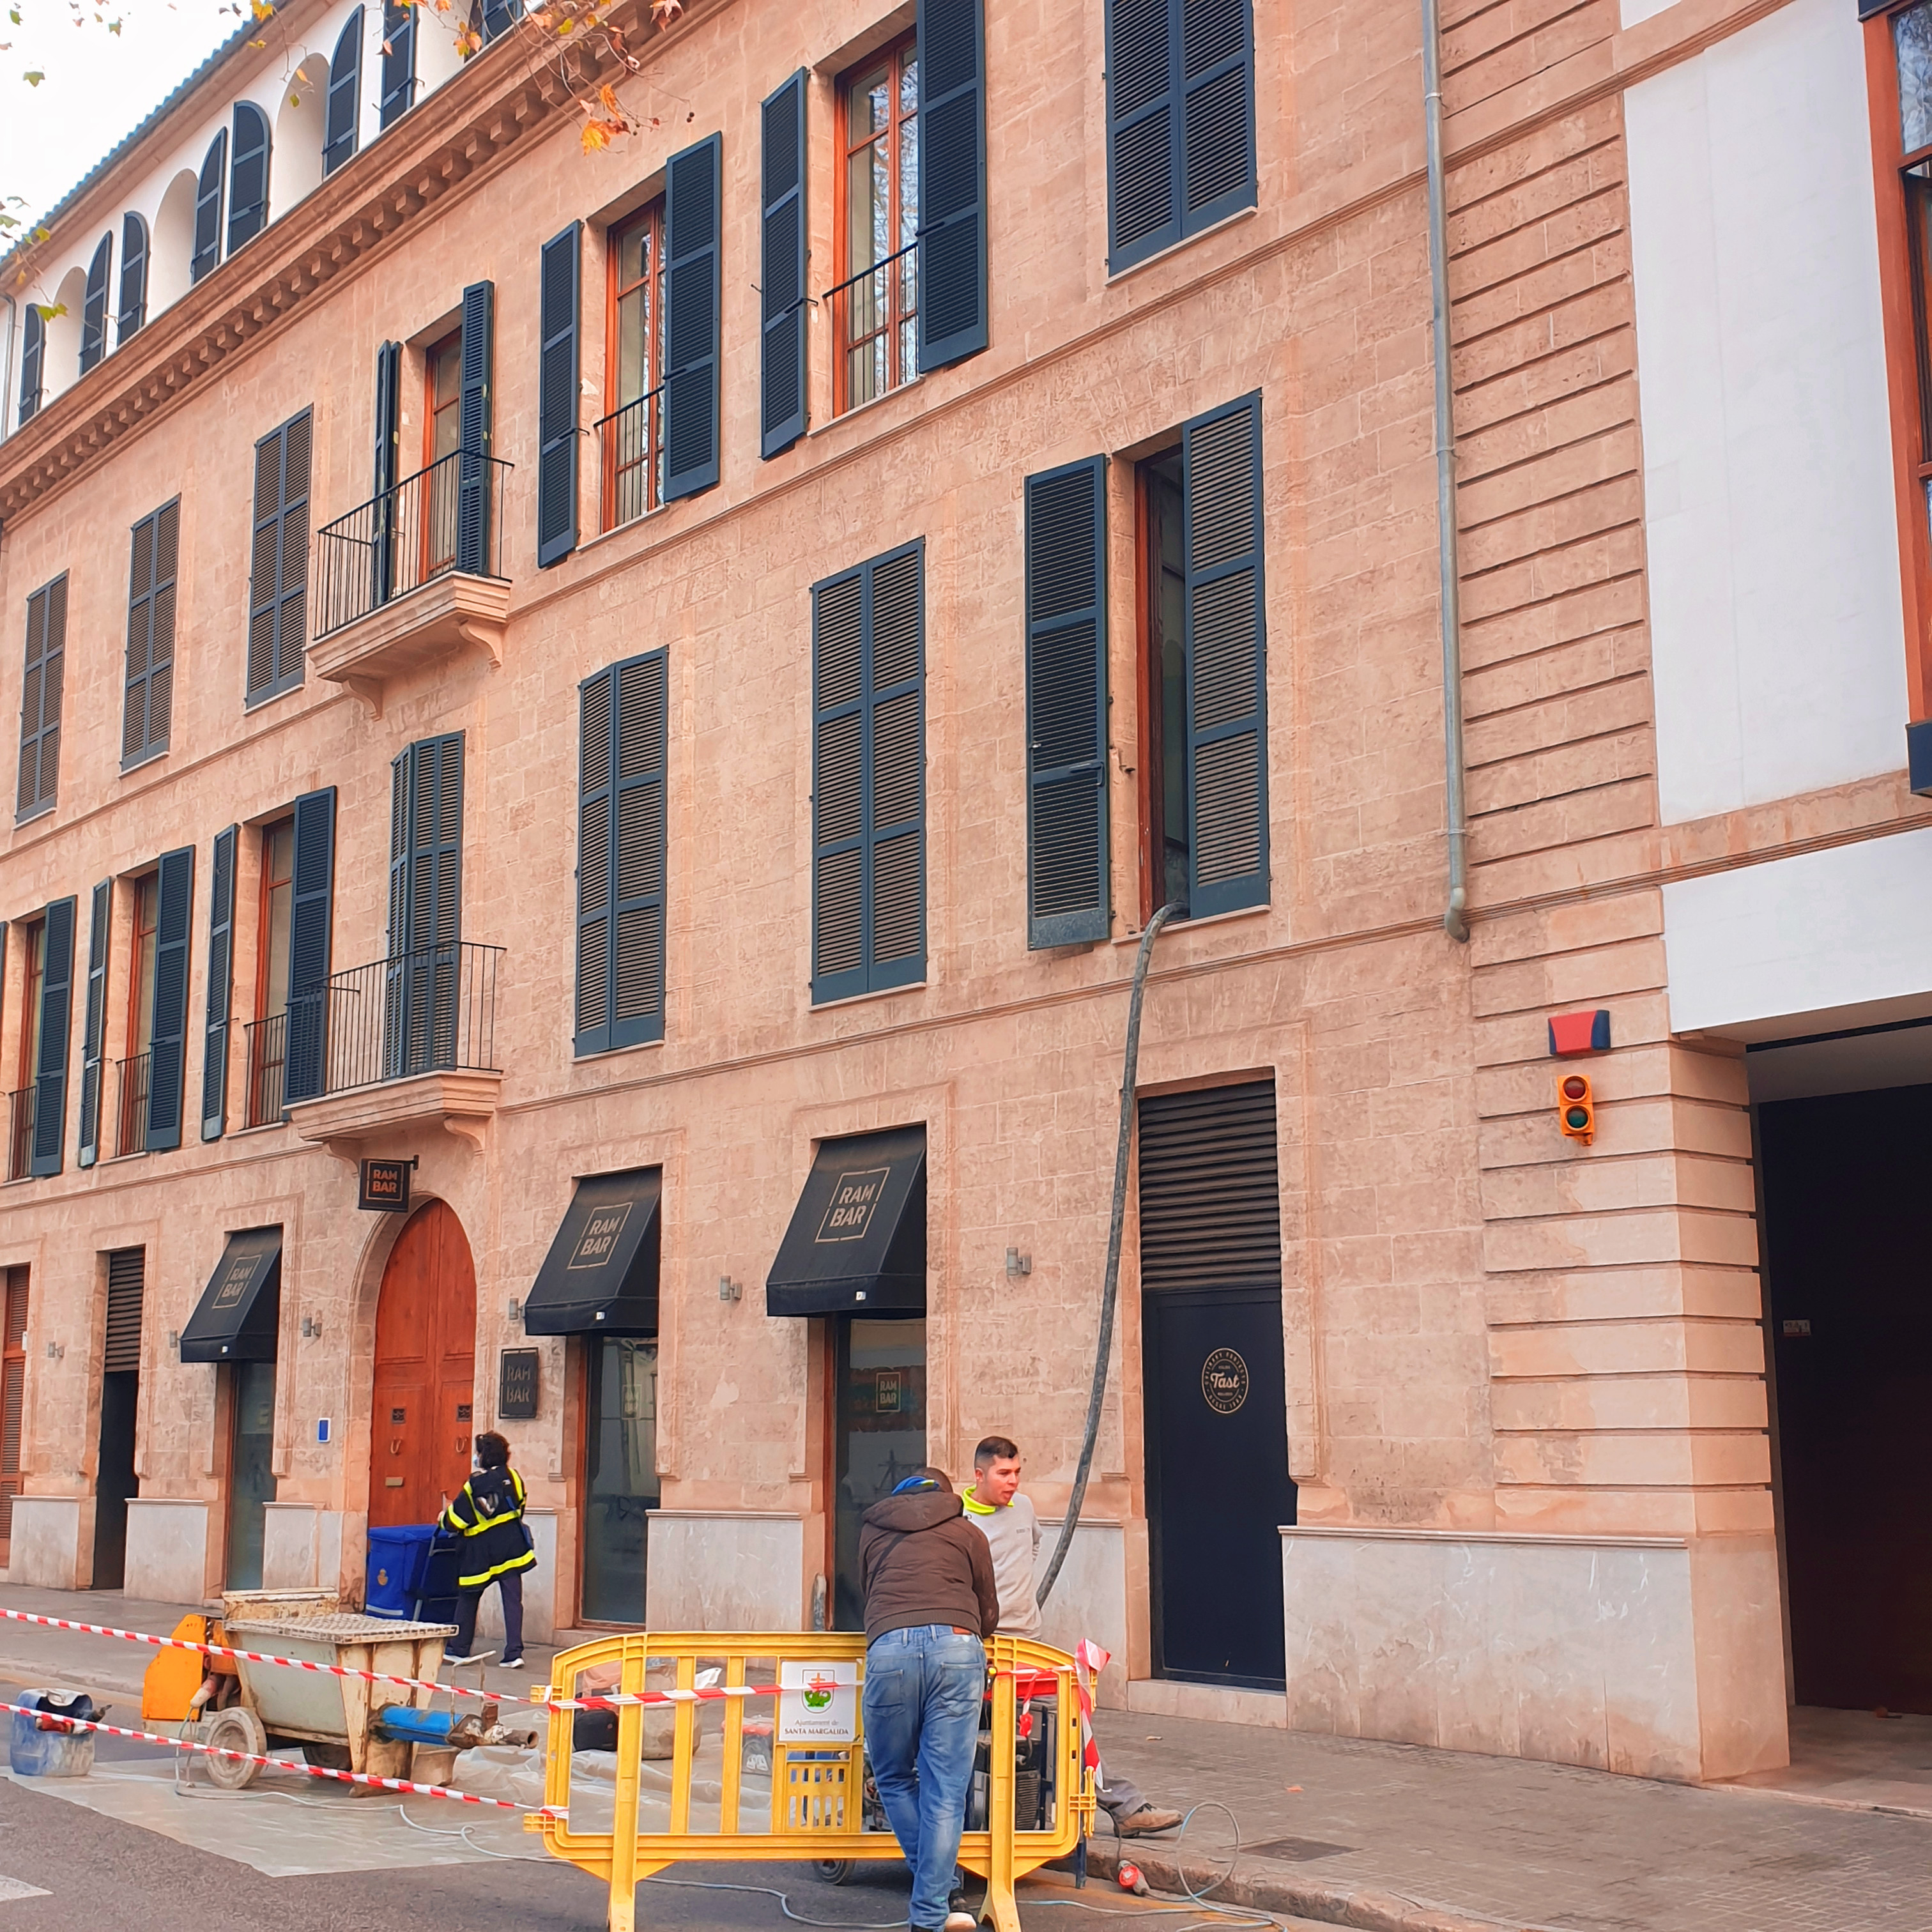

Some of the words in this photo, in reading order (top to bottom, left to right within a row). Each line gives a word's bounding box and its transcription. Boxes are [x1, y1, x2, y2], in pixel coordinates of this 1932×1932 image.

[373, 1169, 397, 1181] RAM
[372, 1181, 397, 1193] BAR
[838, 1183, 876, 1204] RAM
[829, 1205, 867, 1227] BAR
[588, 1216, 621, 1236] RAM
[580, 1236, 611, 1255] BAR
[230, 1266, 254, 1280] RAM
[221, 1282, 244, 1298] BAR
[507, 1364, 530, 1381] RAM
[1210, 1372, 1239, 1388] Tast
[507, 1385, 530, 1402] BAR
[880, 1380, 897, 1392] RAM
[880, 1392, 897, 1404] BAR
